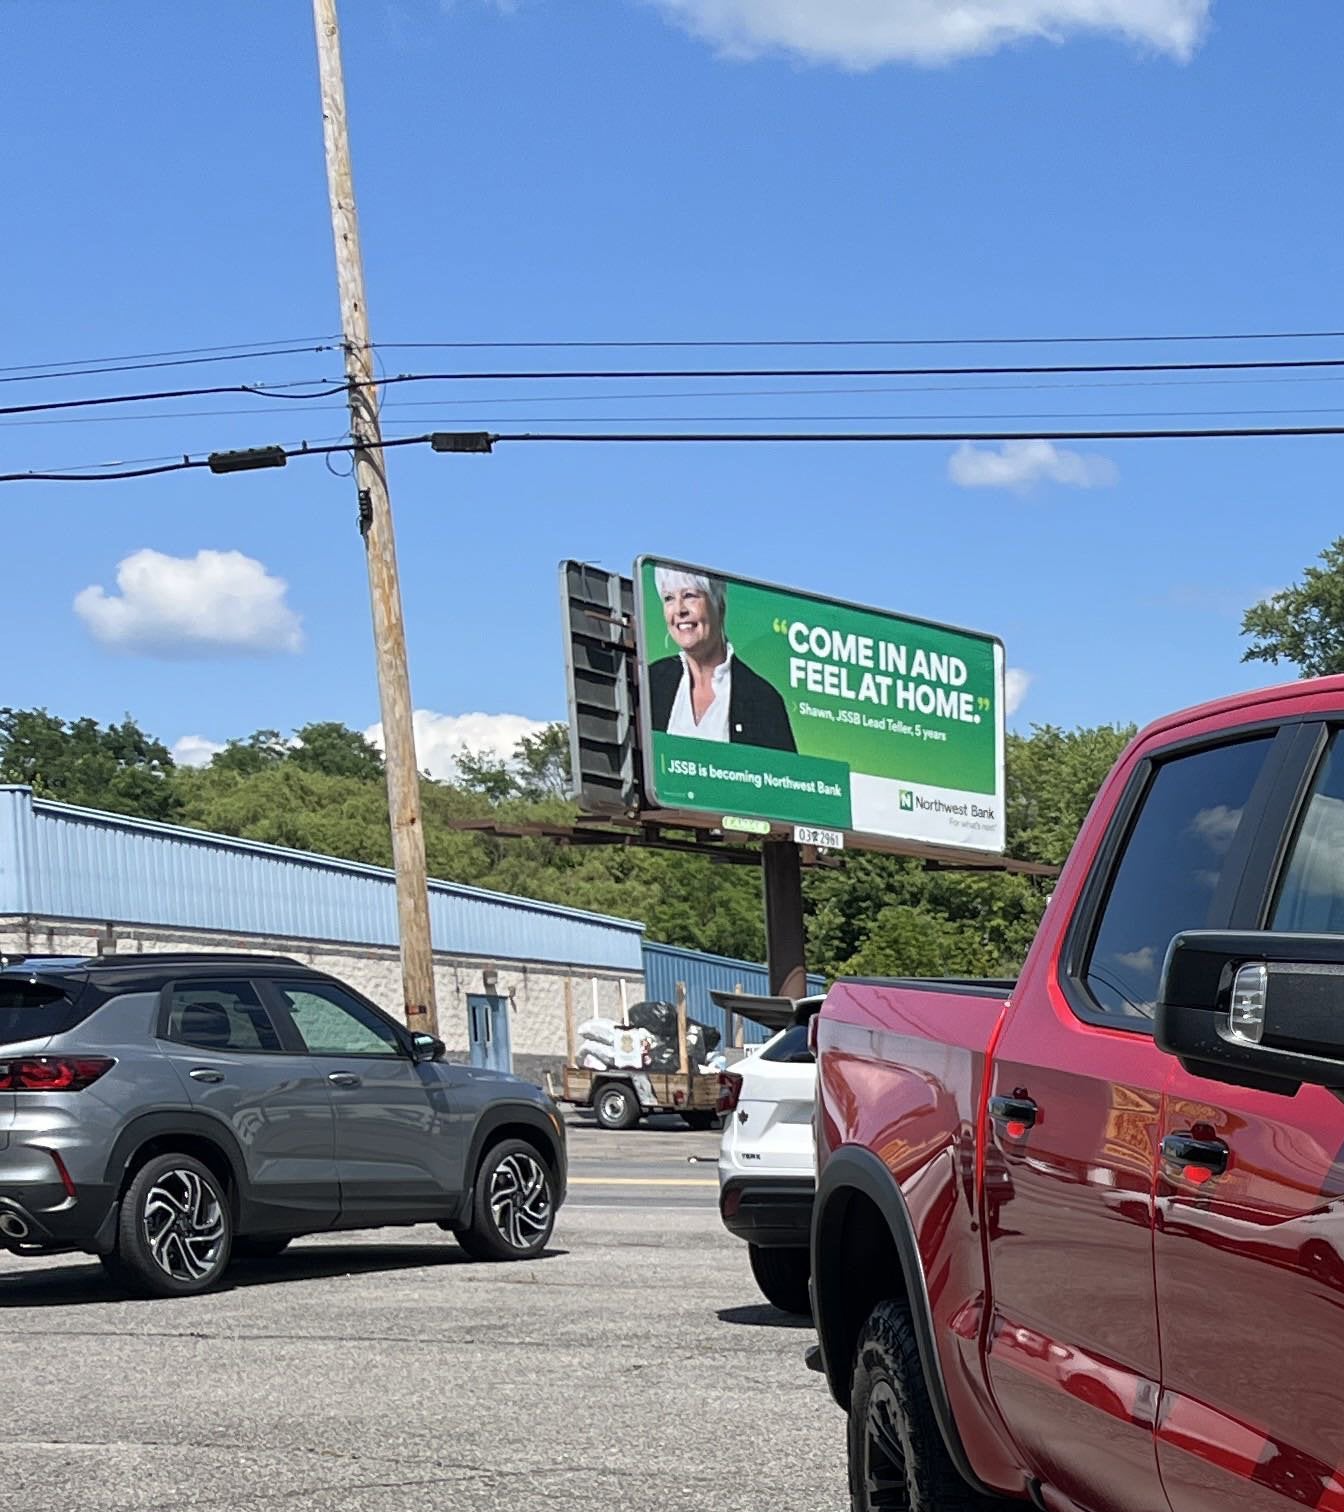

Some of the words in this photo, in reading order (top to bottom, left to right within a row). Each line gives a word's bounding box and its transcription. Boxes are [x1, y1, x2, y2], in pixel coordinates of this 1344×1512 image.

[789, 657, 856, 700] FEEL
[858, 672, 893, 706] AT
[878, 640, 906, 676] IN
[910, 649, 968, 687] AND
[799, 702, 835, 721] Shawn,
[836, 709, 861, 725] JSSB
[862, 714, 886, 730] Lead
[886, 719, 914, 737] Teller,
[914, 724, 922, 737] 5
[922, 728, 947, 742] years
[667, 759, 697, 776] JSSB
[698, 763, 708, 778] is
[709, 764, 763, 789] becoming
[763, 772, 816, 794] Northwest
[817, 781, 842, 798] Bank
[915, 795, 968, 817] Northwest
[971, 804, 995, 820] Bank
